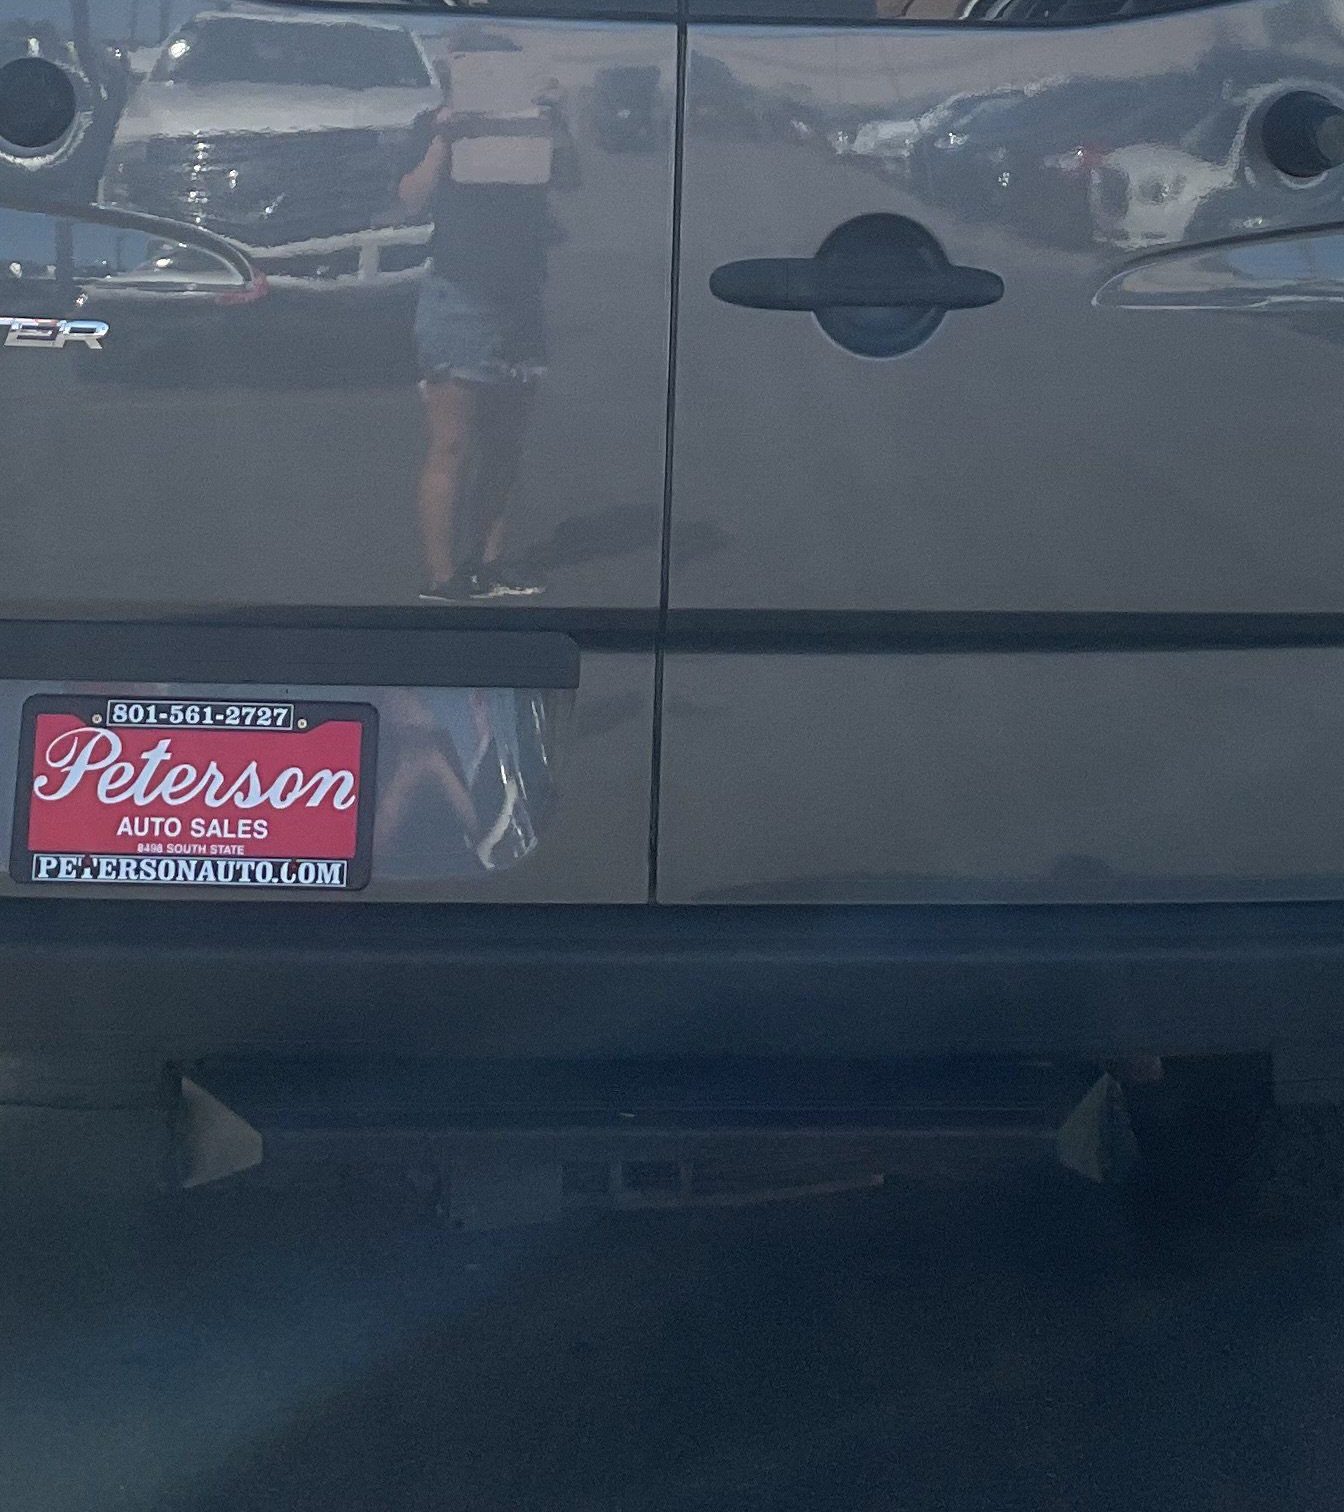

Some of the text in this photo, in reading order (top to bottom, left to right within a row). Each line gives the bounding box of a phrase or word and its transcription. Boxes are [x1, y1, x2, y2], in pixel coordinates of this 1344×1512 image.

[112, 703, 288, 726] 801-561-2727
[33, 727, 356, 810] Peterson
[116, 817, 268, 840] AUTO SALES
[166, 843, 207, 855] SOUTH
[210, 844, 245, 856] STATE
